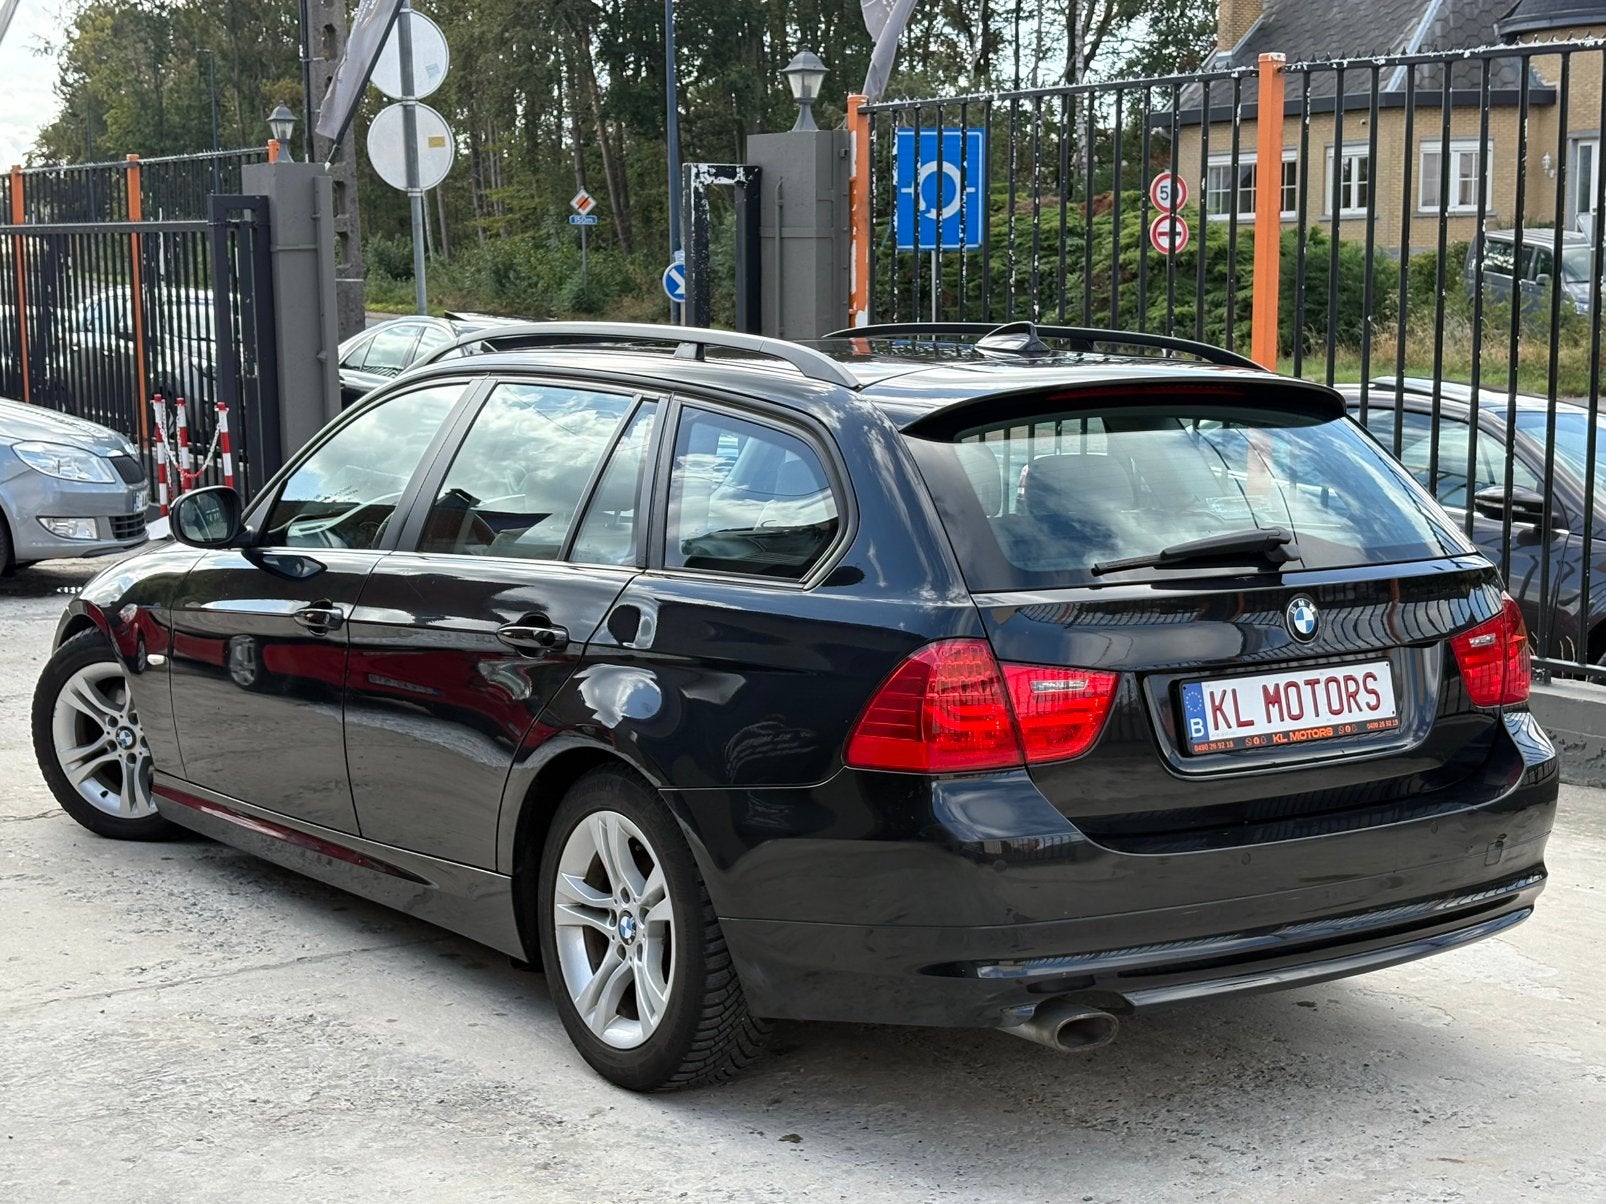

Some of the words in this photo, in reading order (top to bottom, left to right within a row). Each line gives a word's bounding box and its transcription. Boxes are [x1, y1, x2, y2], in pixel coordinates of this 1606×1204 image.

[1160, 186, 1179, 201] 5
[1209, 688, 1255, 731] KL
[1262, 671, 1381, 724] MOTORS
[1190, 718, 1205, 738] B
[1272, 733, 1288, 744] KL
[1289, 727, 1334, 742] MOTORS
